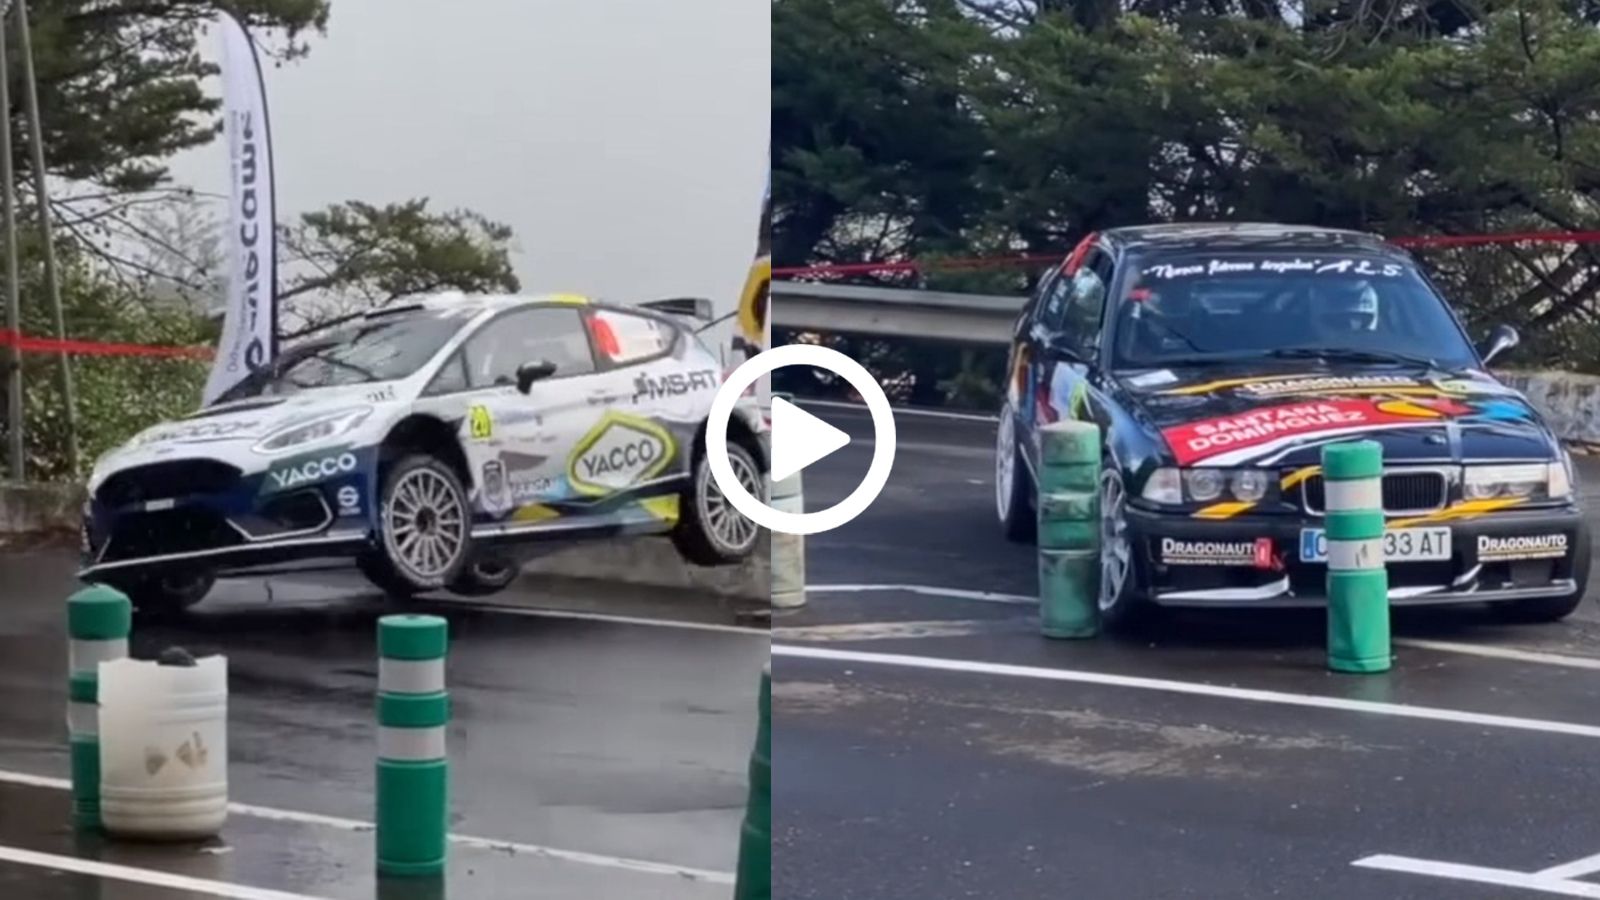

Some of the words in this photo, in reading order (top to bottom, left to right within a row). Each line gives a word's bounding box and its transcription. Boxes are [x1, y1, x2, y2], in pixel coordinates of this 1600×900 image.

[1194, 403, 1338, 435] SANTANA
[271, 452, 357, 488] YACCO
[583, 439, 655, 478] YACCO
[1161, 537, 1257, 554] DRAGONAUT
[1420, 530, 1448, 556] AT
[1477, 533, 1567, 552] DRAGONAUTO
